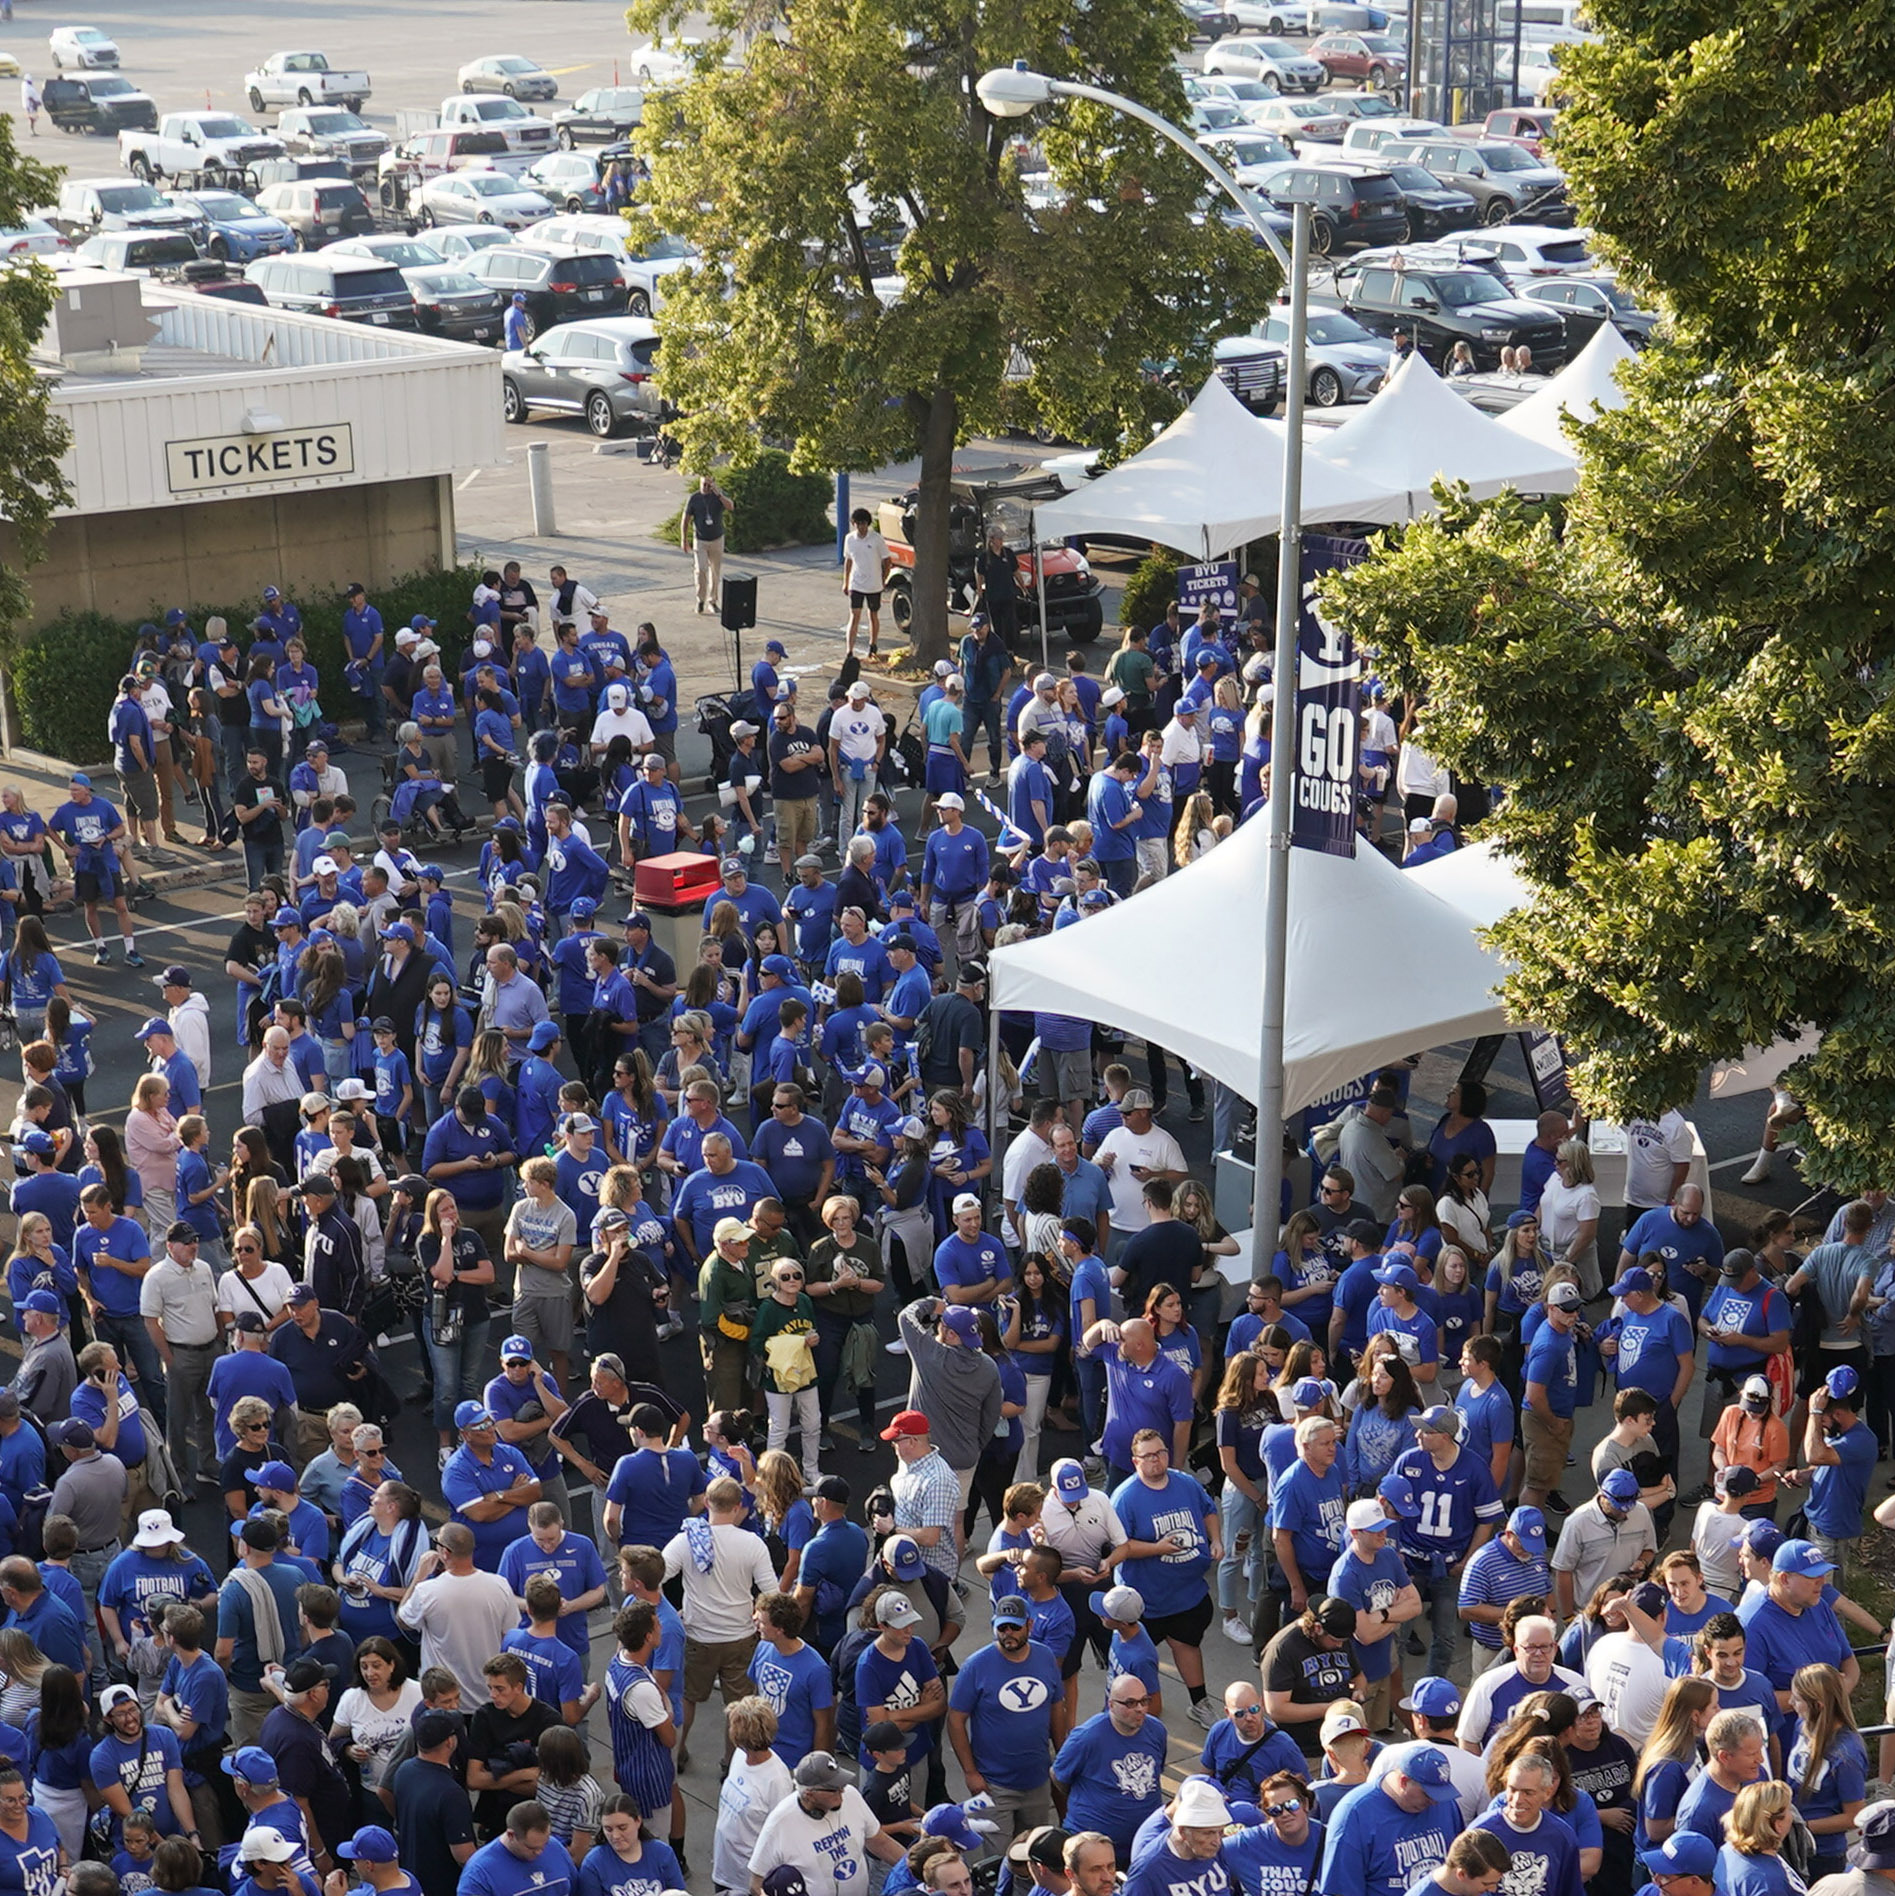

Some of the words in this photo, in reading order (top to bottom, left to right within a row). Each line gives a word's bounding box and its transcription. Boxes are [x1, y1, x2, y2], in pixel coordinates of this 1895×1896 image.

[184, 434, 337, 478] TICKETS
[1186, 575, 1229, 590] TICKETS
[1195, 567, 1219, 577] BYU
[1300, 702, 1353, 783] GO
[1299, 782, 1351, 817] COUGS
[712, 1189, 747, 1209] BYU
[1152, 1509, 1198, 1540] FOOTBALL
[1417, 1491, 1452, 1537] 11
[135, 1573, 186, 1600] FOOTBALL
[1301, 1651, 1350, 1673] BYU
[119, 1757, 140, 1774] ANY
[813, 1825, 852, 1853] REPPIN
[828, 1845, 848, 1863] THE
[1395, 1836, 1447, 1874] FOOTBALL
[1260, 1866, 1302, 1878] THAT
